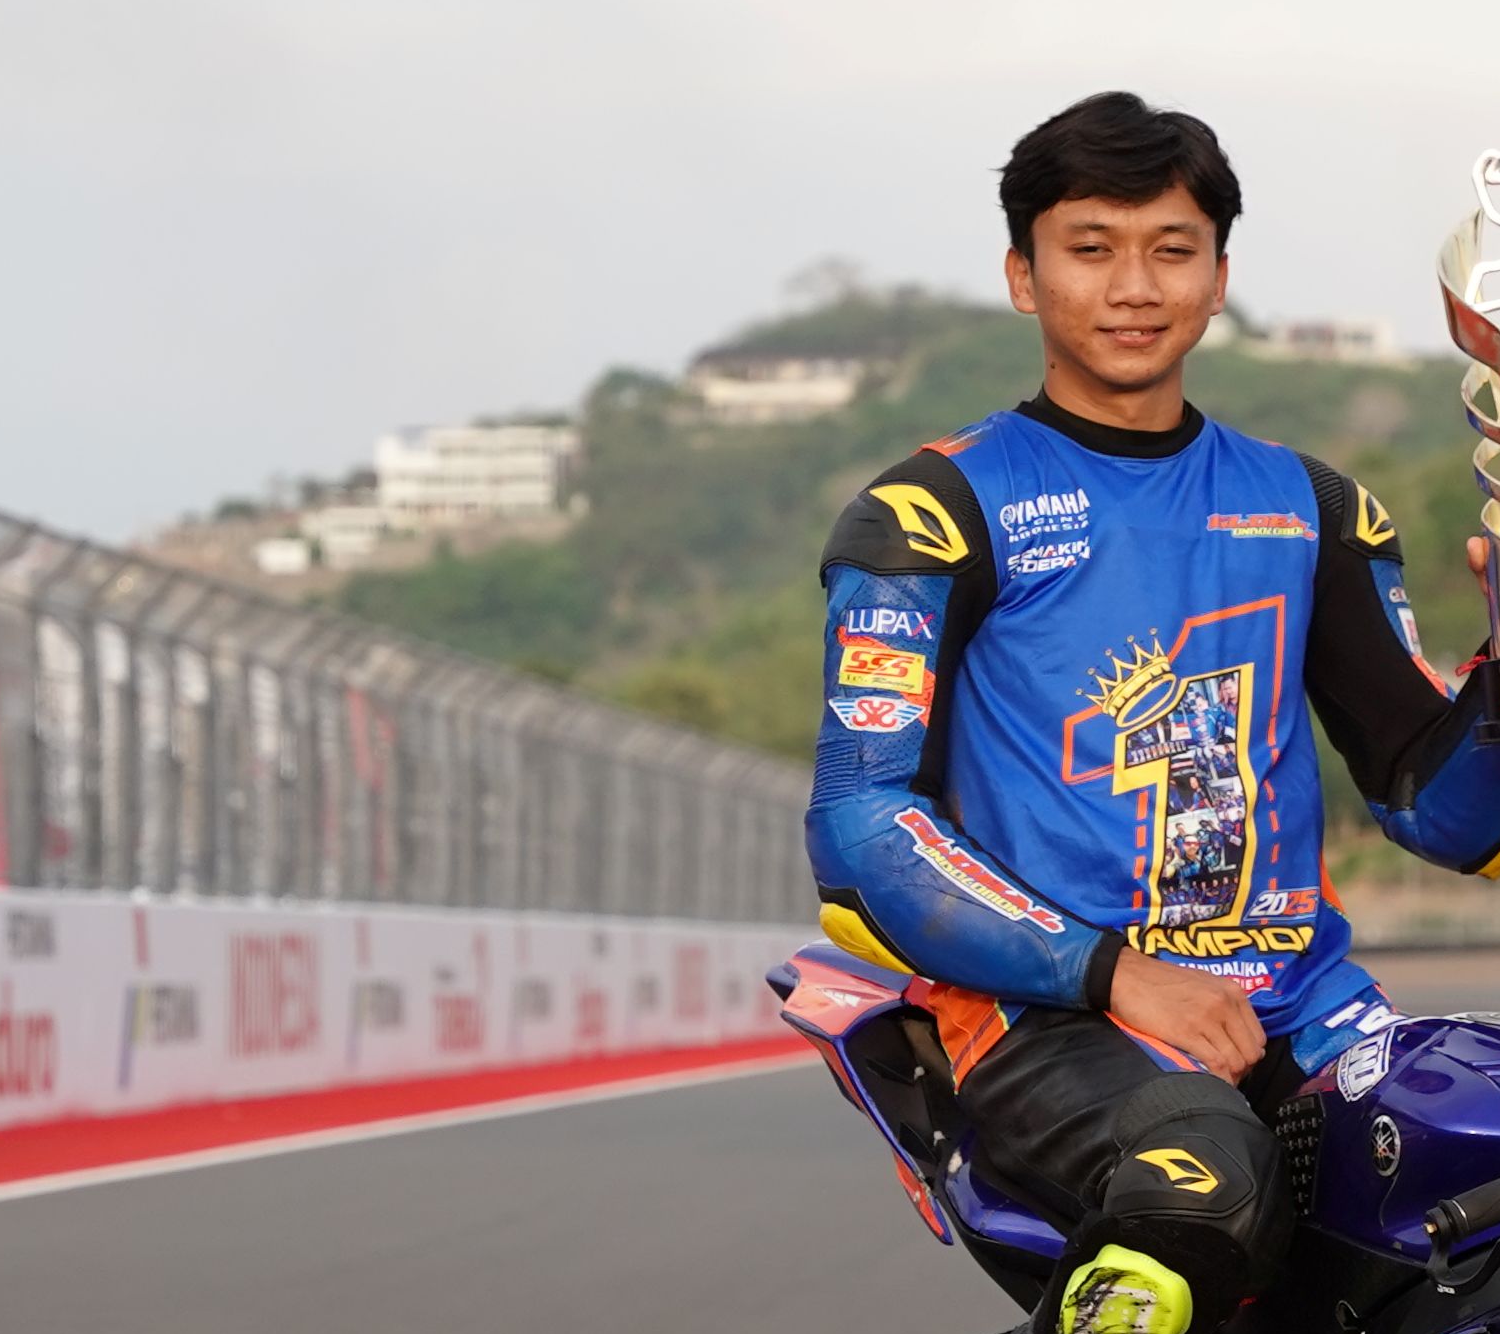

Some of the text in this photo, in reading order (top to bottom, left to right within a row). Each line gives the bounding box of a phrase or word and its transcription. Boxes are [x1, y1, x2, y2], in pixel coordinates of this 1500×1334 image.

[1016, 488, 1091, 524] YAMAHA
[848, 609, 935, 639] LUPAX
[1250, 890, 1318, 916] 2025
